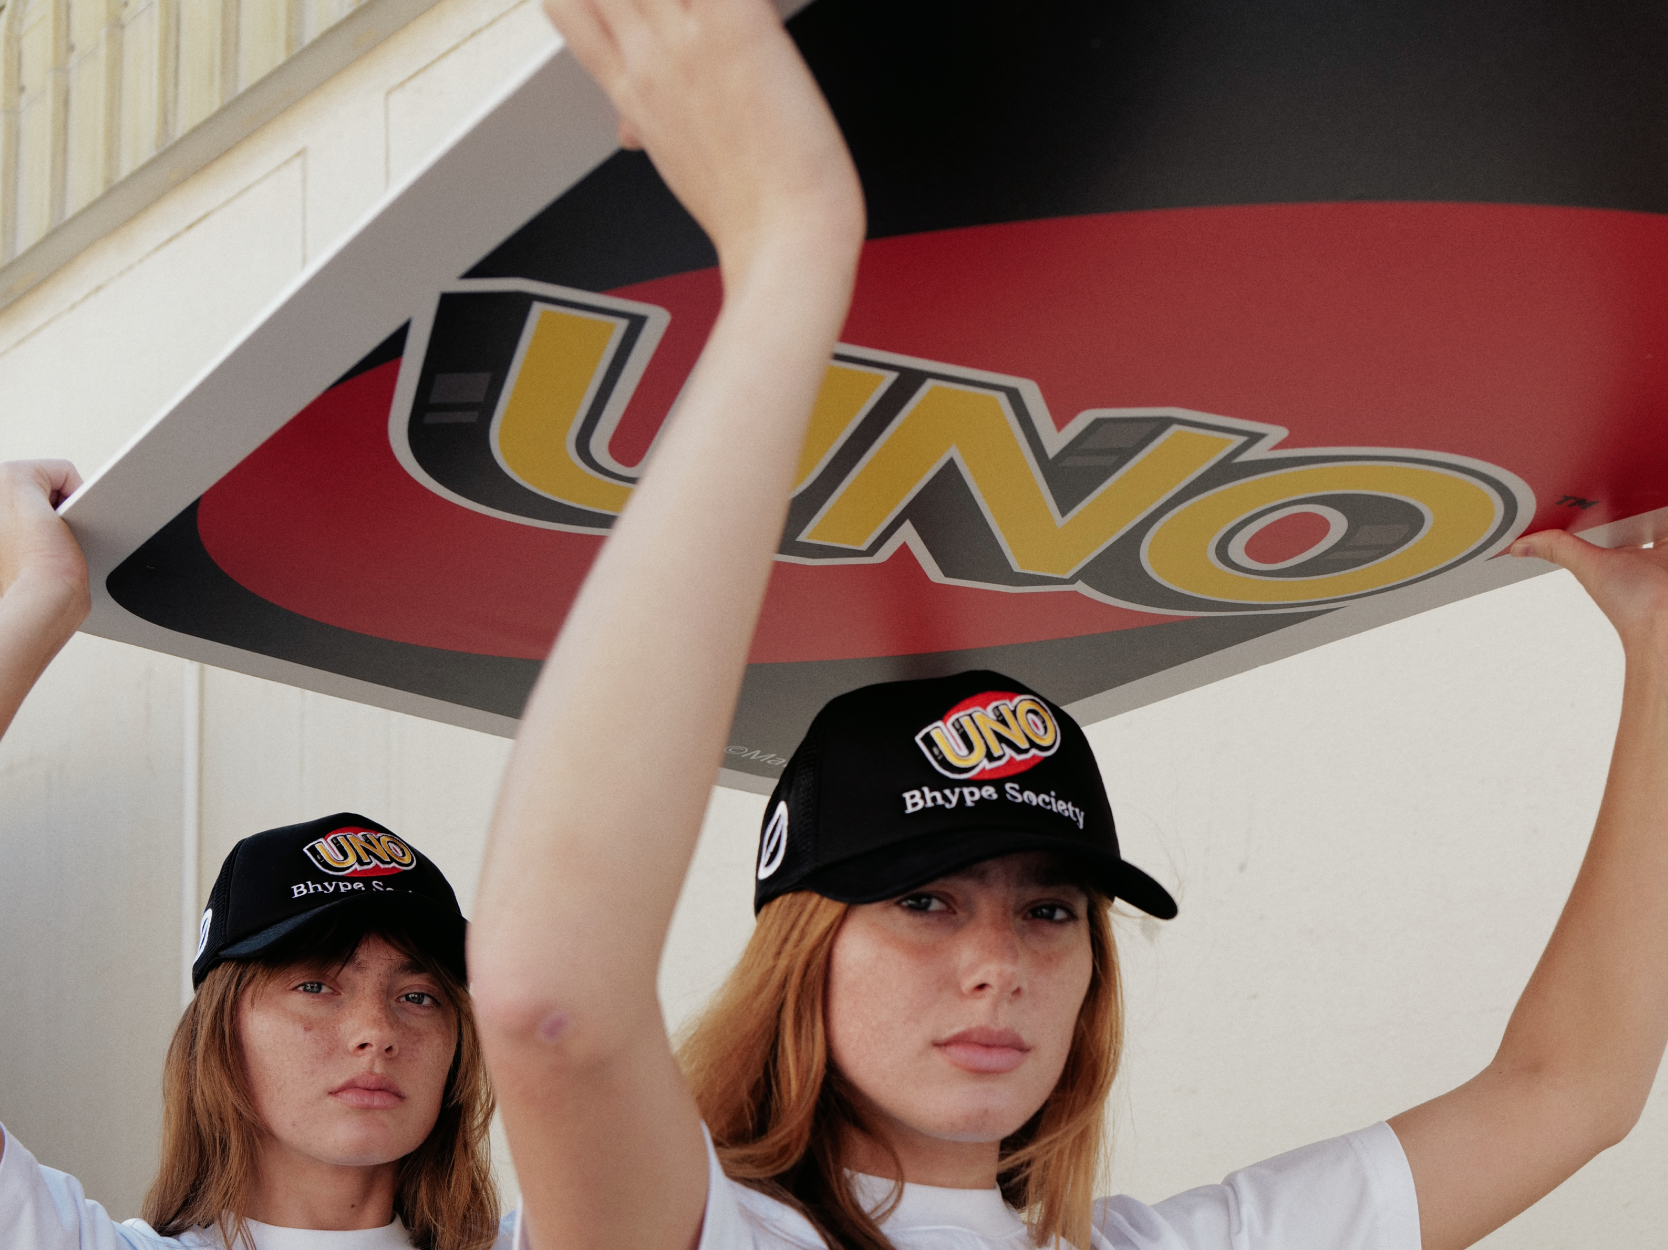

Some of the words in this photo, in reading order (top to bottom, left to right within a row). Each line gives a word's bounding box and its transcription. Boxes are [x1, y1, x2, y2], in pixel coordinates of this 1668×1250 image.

[389, 277, 1538, 616] UNO
[723, 745, 788, 768] ©Ma
[915, 694, 1061, 780] UNO
[902, 785, 998, 814] Bhype
[1005, 782, 1085, 830] Society
[303, 831, 417, 876] UNO
[290, 880, 366, 899] Bhype
